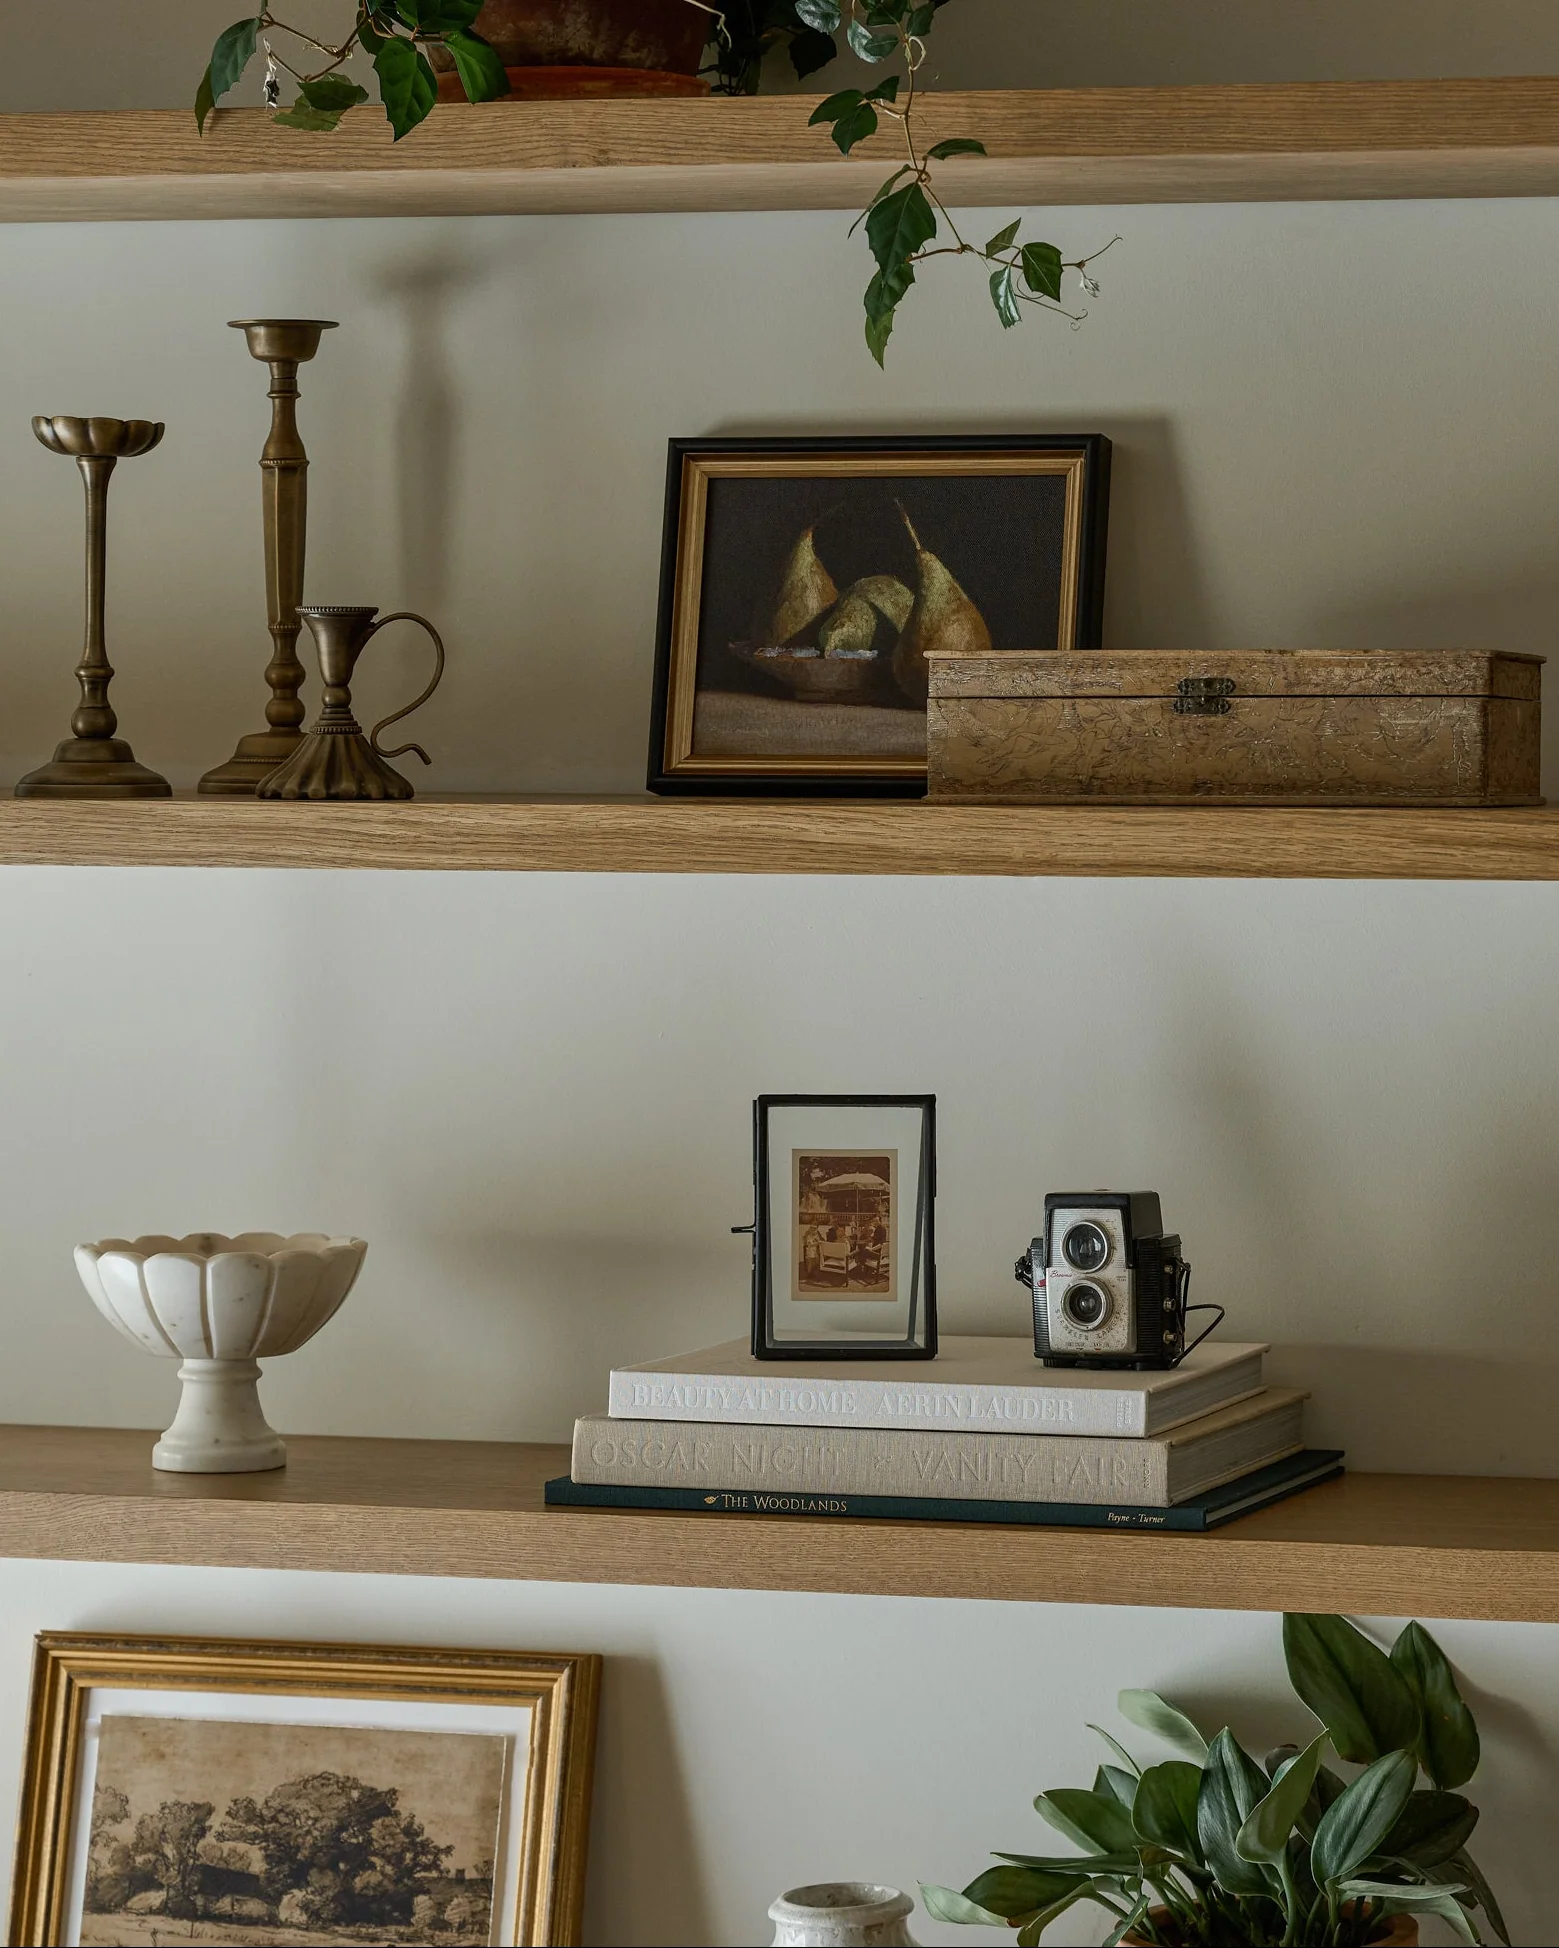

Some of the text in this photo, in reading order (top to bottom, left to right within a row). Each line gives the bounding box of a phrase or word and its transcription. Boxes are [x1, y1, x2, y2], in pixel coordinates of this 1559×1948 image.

[631, 1383, 1077, 1423] BEAUTY AT HOME AERIN LAUDER
[590, 1439, 711, 1471] OSCAR
[911, 1450, 1037, 1484] VANITY
[1051, 1453, 1128, 1488] FAIR
[721, 1493, 848, 1513] THE WOODLANDS
[1107, 1511, 1130, 1524] Payne
[1138, 1513, 1166, 1524] Turner
